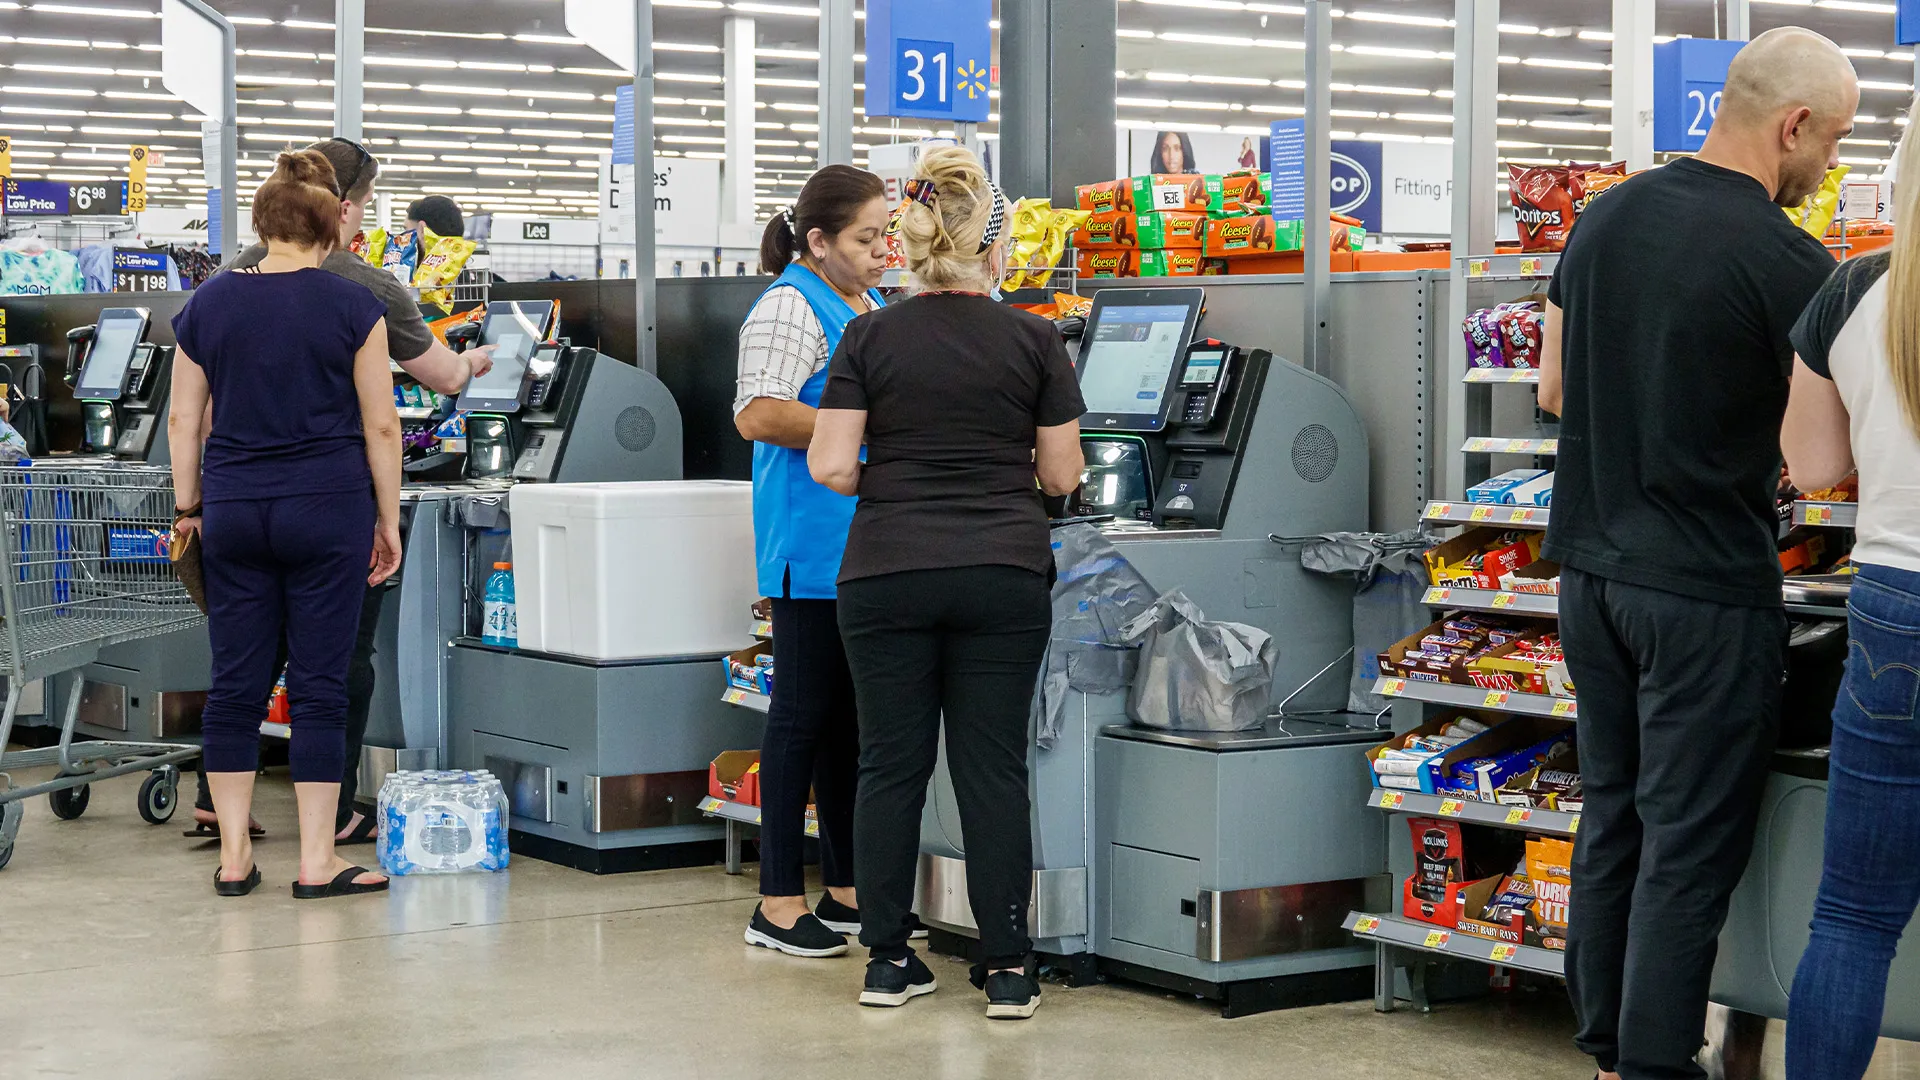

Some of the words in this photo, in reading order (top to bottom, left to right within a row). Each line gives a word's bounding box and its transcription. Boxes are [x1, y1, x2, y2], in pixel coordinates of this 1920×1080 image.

[902, 49, 947, 103] 31
[132, 181, 144, 194] D
[1395, 177, 1441, 201] Fitting
[7, 199, 29, 210] Low
[30, 199, 56, 210] Price
[130, 197, 145, 209] 23
[1513, 205, 1561, 225] Doritos
[526, 223, 548, 239] Lee
[1085, 217, 1113, 232] Reese's
[1219, 221, 1252, 238] Reese's
[126, 255, 142, 265] Low
[141, 257, 159, 267] Price
[1089, 253, 1118, 269] Reese's
[16, 284, 51, 296] MOM
[1178, 483, 1188, 492] 37
[1498, 549, 1519, 565] SHARE
[1505, 562, 1516, 571] SIZE
[1410, 671, 1438, 682] SNICKERS
[1538, 769, 1580, 786] HERSHEY'S
[1437, 787, 1465, 800] Almond
[1457, 920, 1480, 934] SWEET
[1480, 925, 1499, 938] BABY
[1499, 929, 1519, 942] RAY'S
